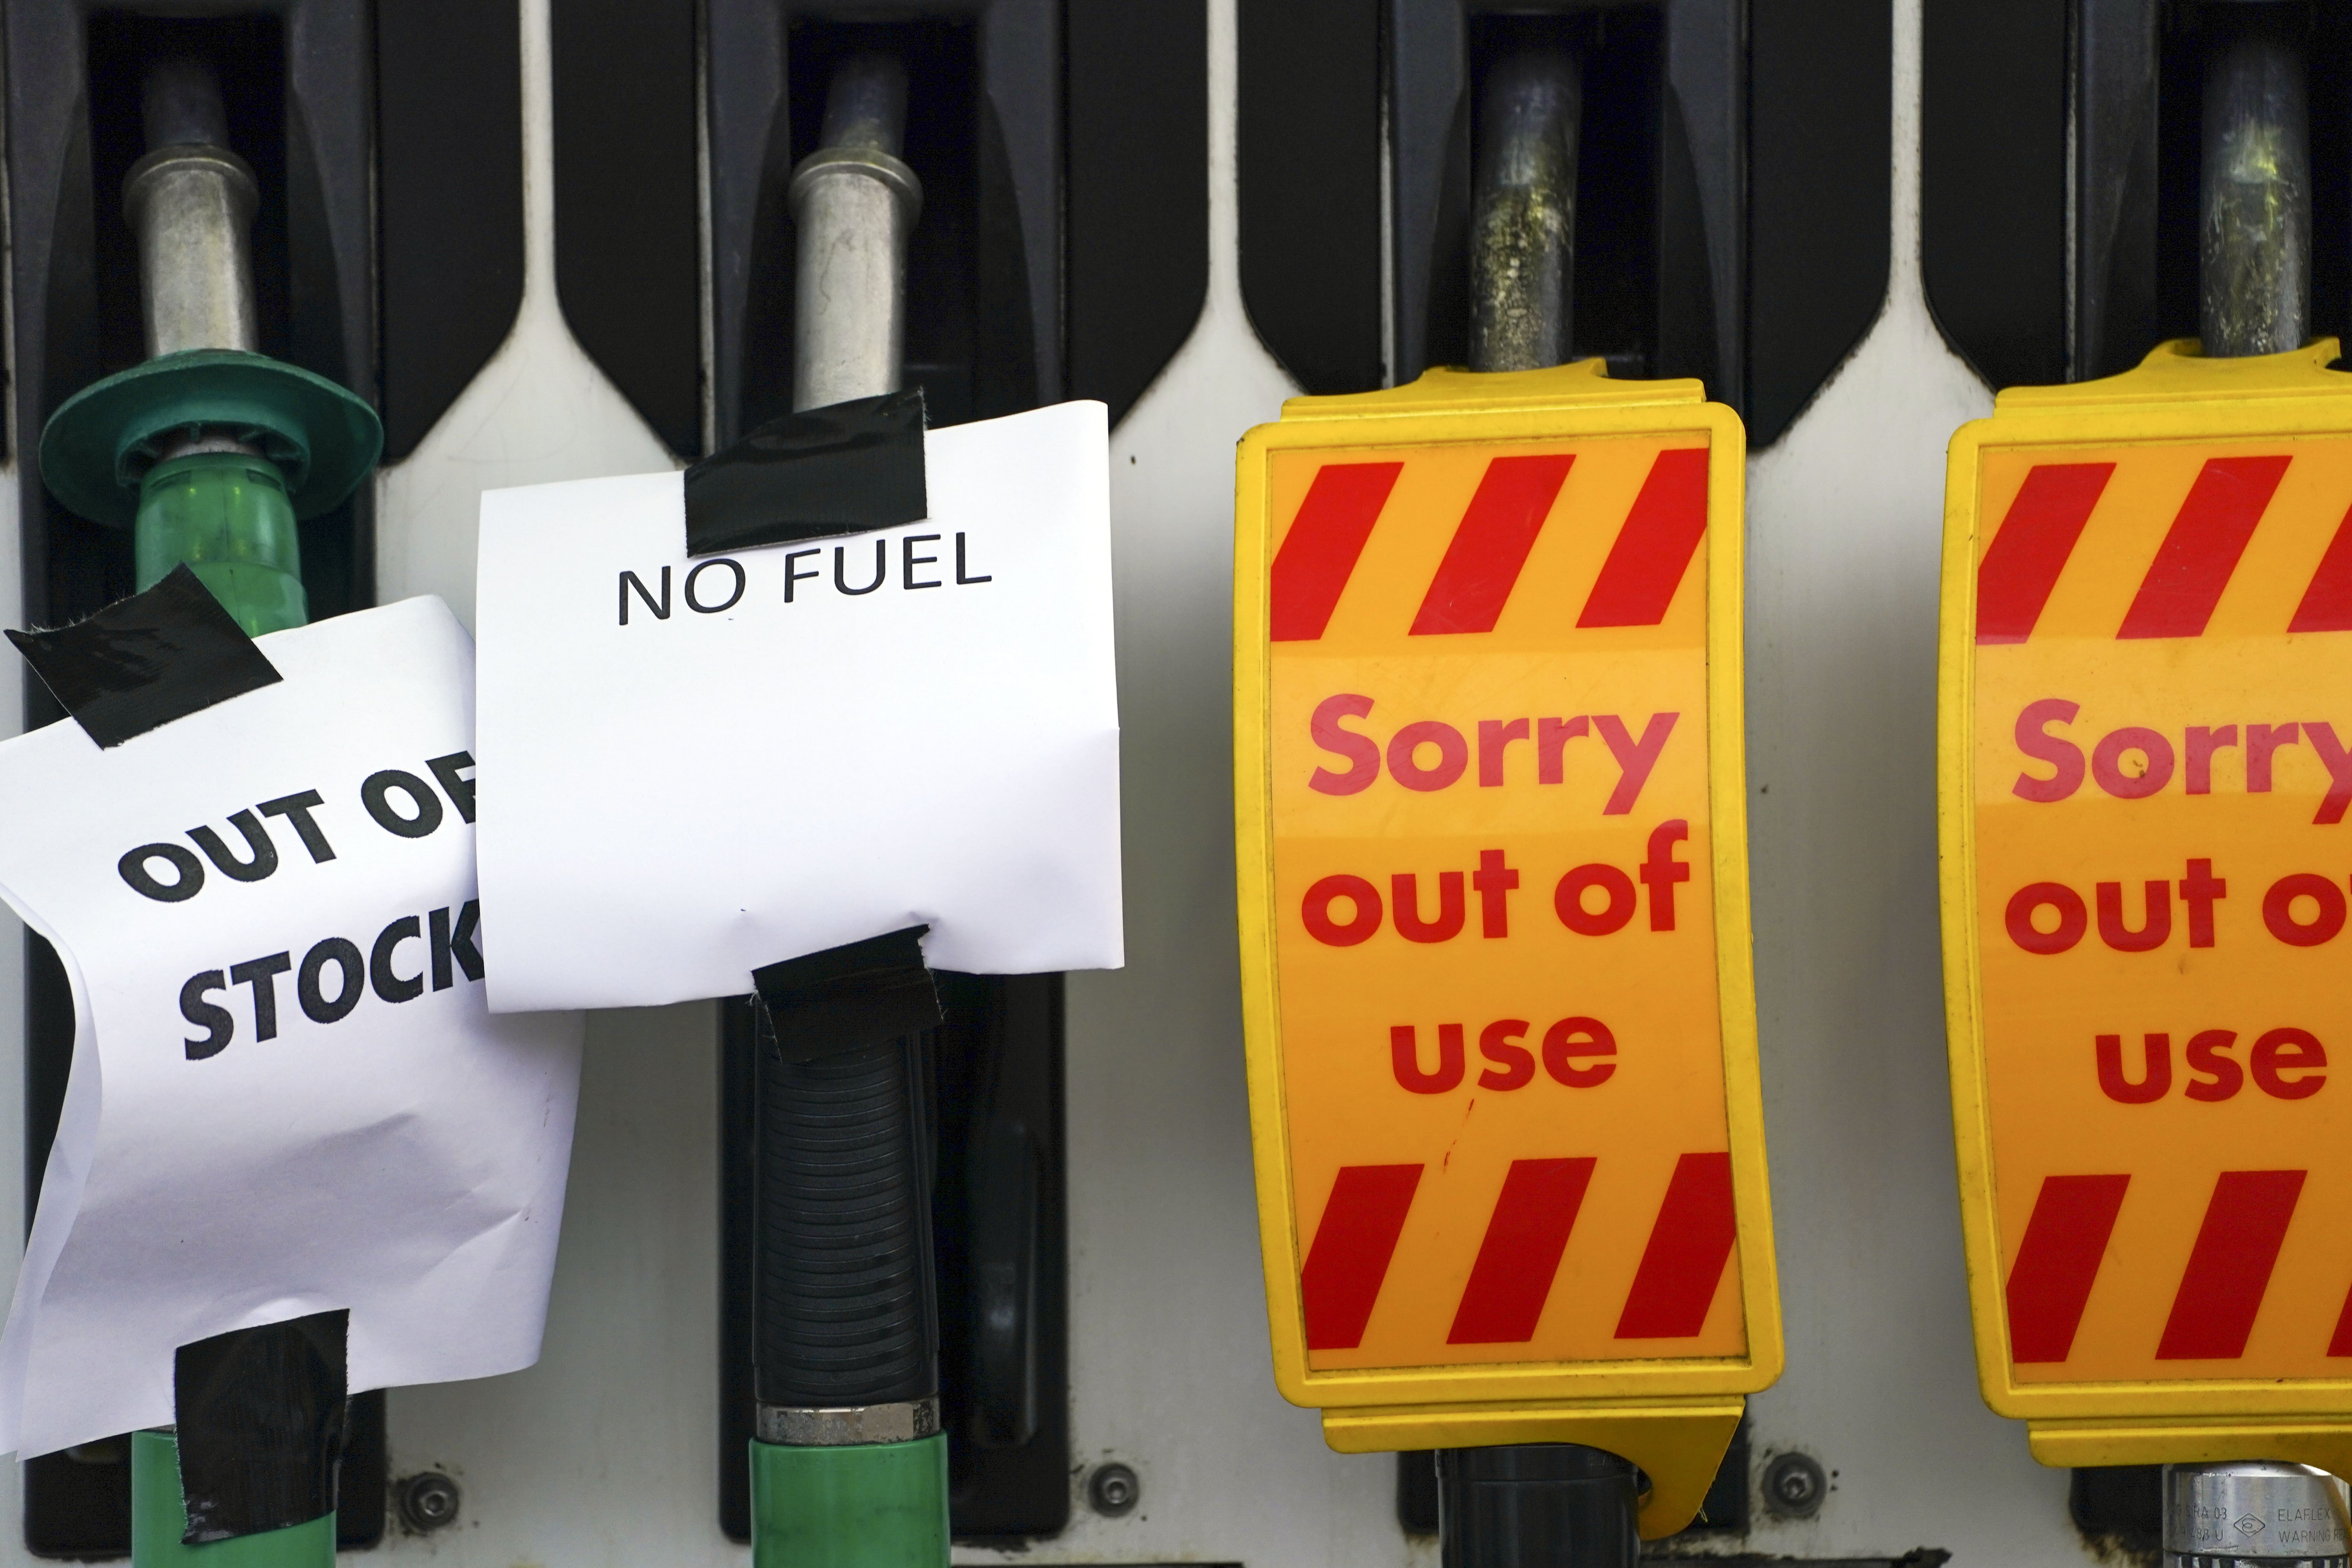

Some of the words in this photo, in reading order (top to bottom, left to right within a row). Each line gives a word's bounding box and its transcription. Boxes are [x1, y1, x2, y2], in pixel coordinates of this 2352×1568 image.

[620, 559, 745, 625] NO
[784, 532, 992, 603] FUEL
[1308, 694, 1679, 815] Sorry
[2012, 699, 2352, 826] Sorry
[118, 789, 336, 902] OUT
[361, 751, 475, 838] OF
[1301, 849, 1519, 947] out
[1554, 819, 1690, 937] of
[2004, 857, 2227, 956] out
[2261, 872, 2352, 949] o
[179, 899, 485, 1060] STOCK
[1389, 1015, 1617, 1096] use
[2092, 1025, 2331, 1109] use
[2215, 1529, 2223, 1541] U
[2278, 1508, 2330, 1521] ELAFLEX
[2279, 1529, 2330, 1543] WARNING
